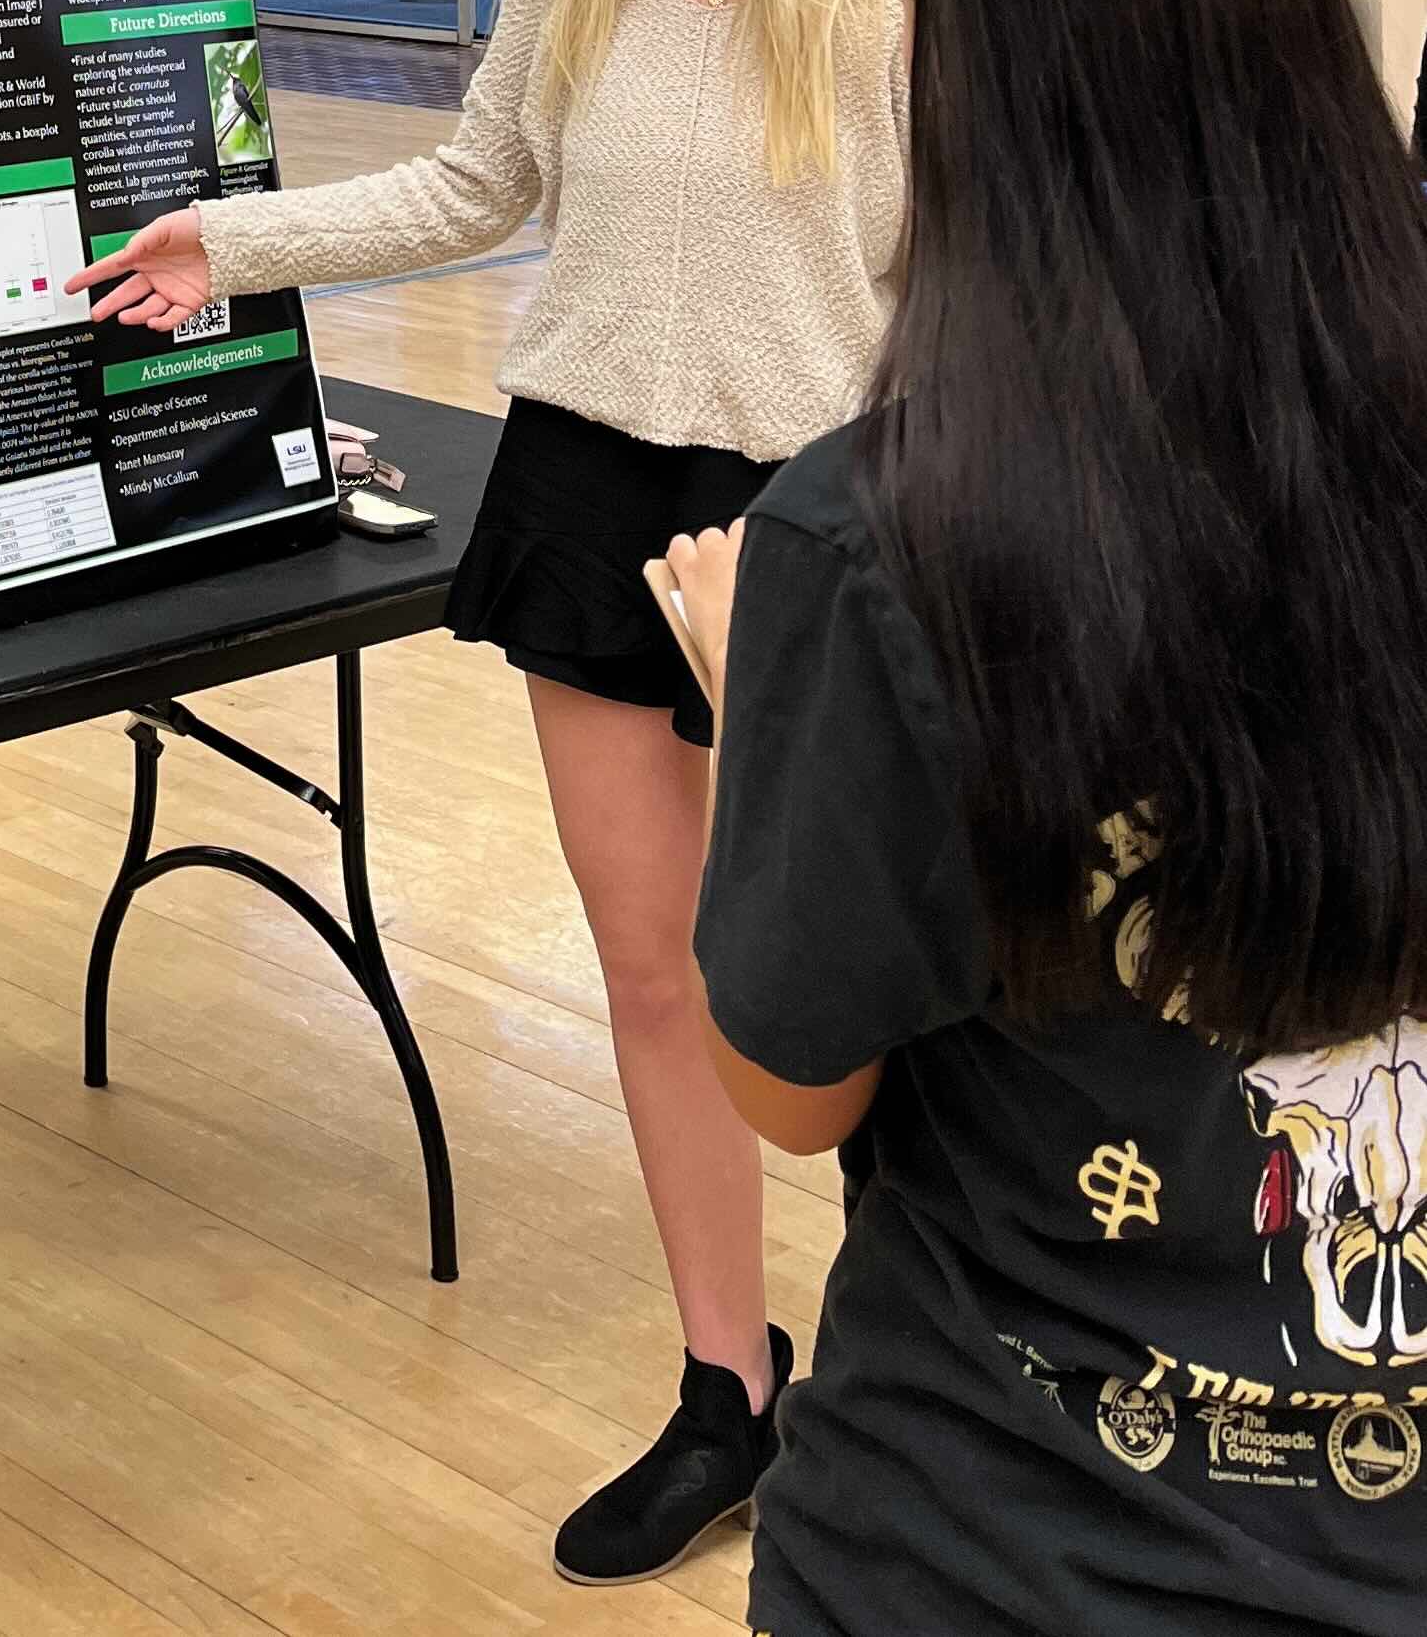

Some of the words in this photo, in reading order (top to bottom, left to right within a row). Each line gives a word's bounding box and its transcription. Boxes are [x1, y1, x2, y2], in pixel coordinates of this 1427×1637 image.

[109, 17, 155, 32] Future
[157, 10, 226, 28] Directions
[140, 345, 263, 380] Acknowledgements
[110, 408, 130, 422] LSU
[130, 403, 163, 418] College
[163, 396, 174, 410] of
[174, 394, 207, 408] Science
[113, 426, 168, 447] Department
[168, 420, 178, 434] of
[179, 412, 221, 432] Biological
[220, 407, 258, 422] Sciences
[117, 457, 142, 472] Janet
[142, 448, 184, 466] Mansaray
[121, 479, 152, 496] Mindy
[152, 470, 199, 488] McCallum
[1243, 1412, 1267, 1429] The
[1222, 1425, 1316, 1450] Orthopaedic
[1226, 1443, 1272, 1467] Group
